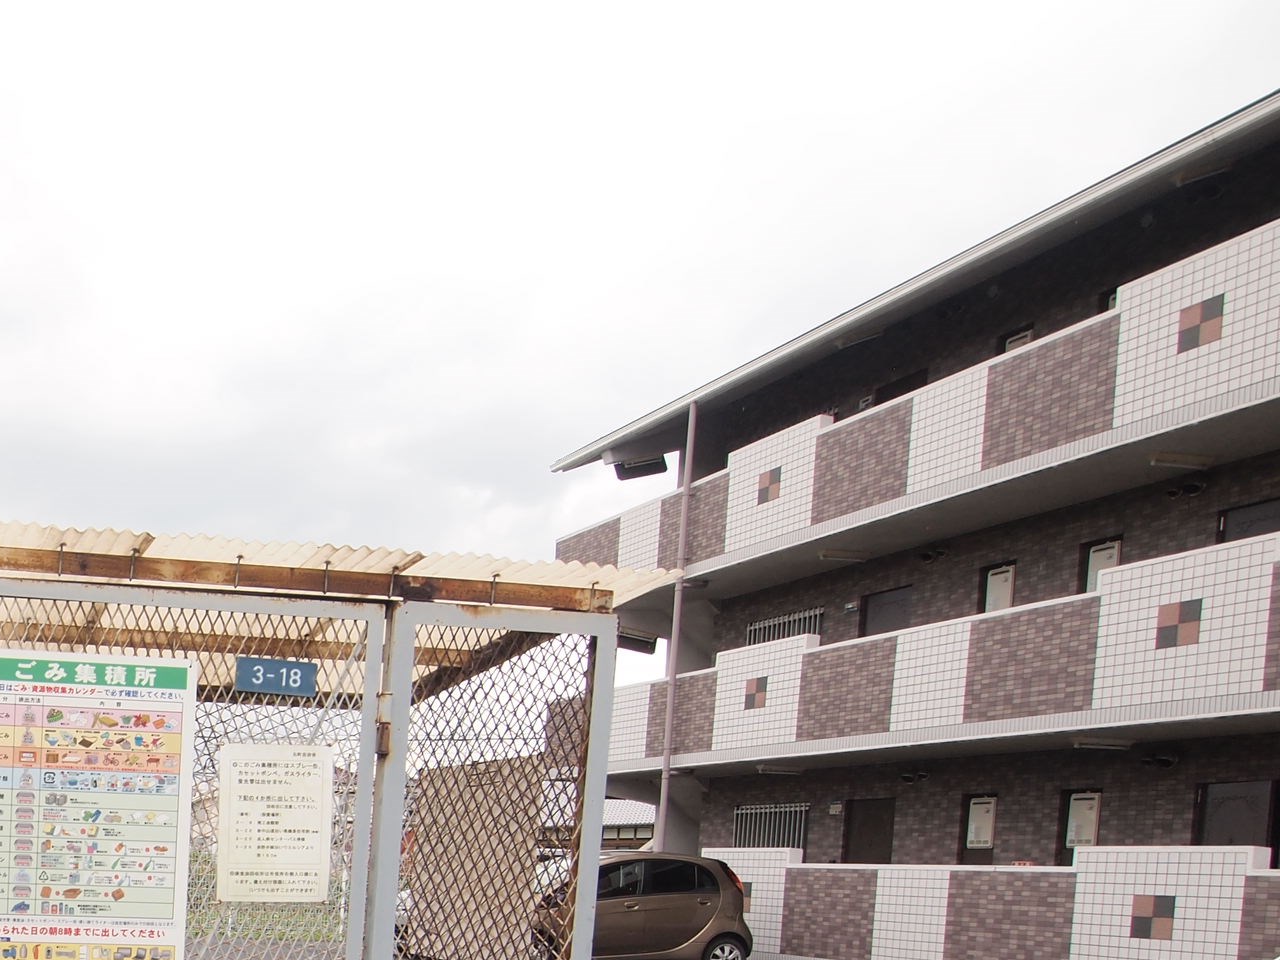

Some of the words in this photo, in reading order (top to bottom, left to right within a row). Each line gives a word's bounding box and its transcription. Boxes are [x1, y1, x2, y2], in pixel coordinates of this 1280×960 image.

[15, 660, 157, 687] ごみ集積所
[251, 665, 301, 688] 3-18
